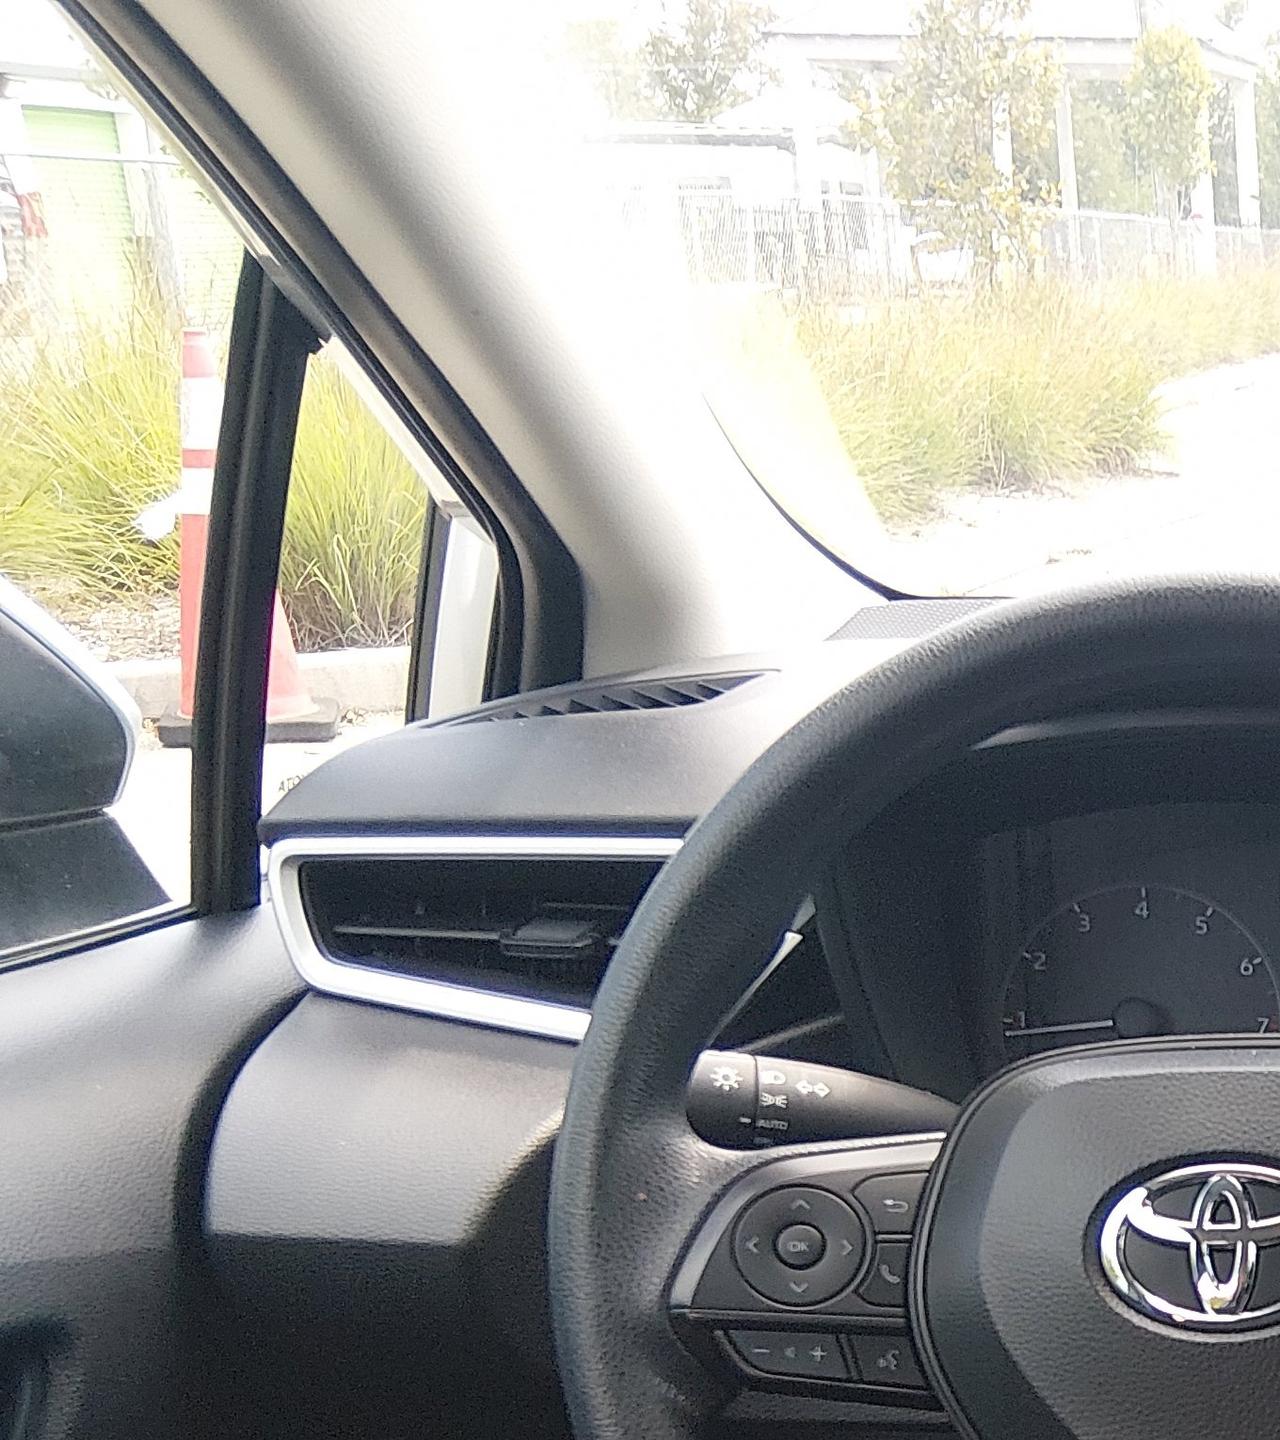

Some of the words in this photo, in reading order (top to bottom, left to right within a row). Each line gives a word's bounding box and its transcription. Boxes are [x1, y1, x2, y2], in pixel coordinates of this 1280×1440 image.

[1134, 901, 1150, 919] 4
[1077, 914, 1091, 933] 3
[1195, 916, 1209, 935] 5
[1033, 951, 1047, 971] 2
[1239, 957, 1254, 976] 6
[1016, 1011, 1026, 1027] 1
[1256, 1017, 1271, 1034] 7
